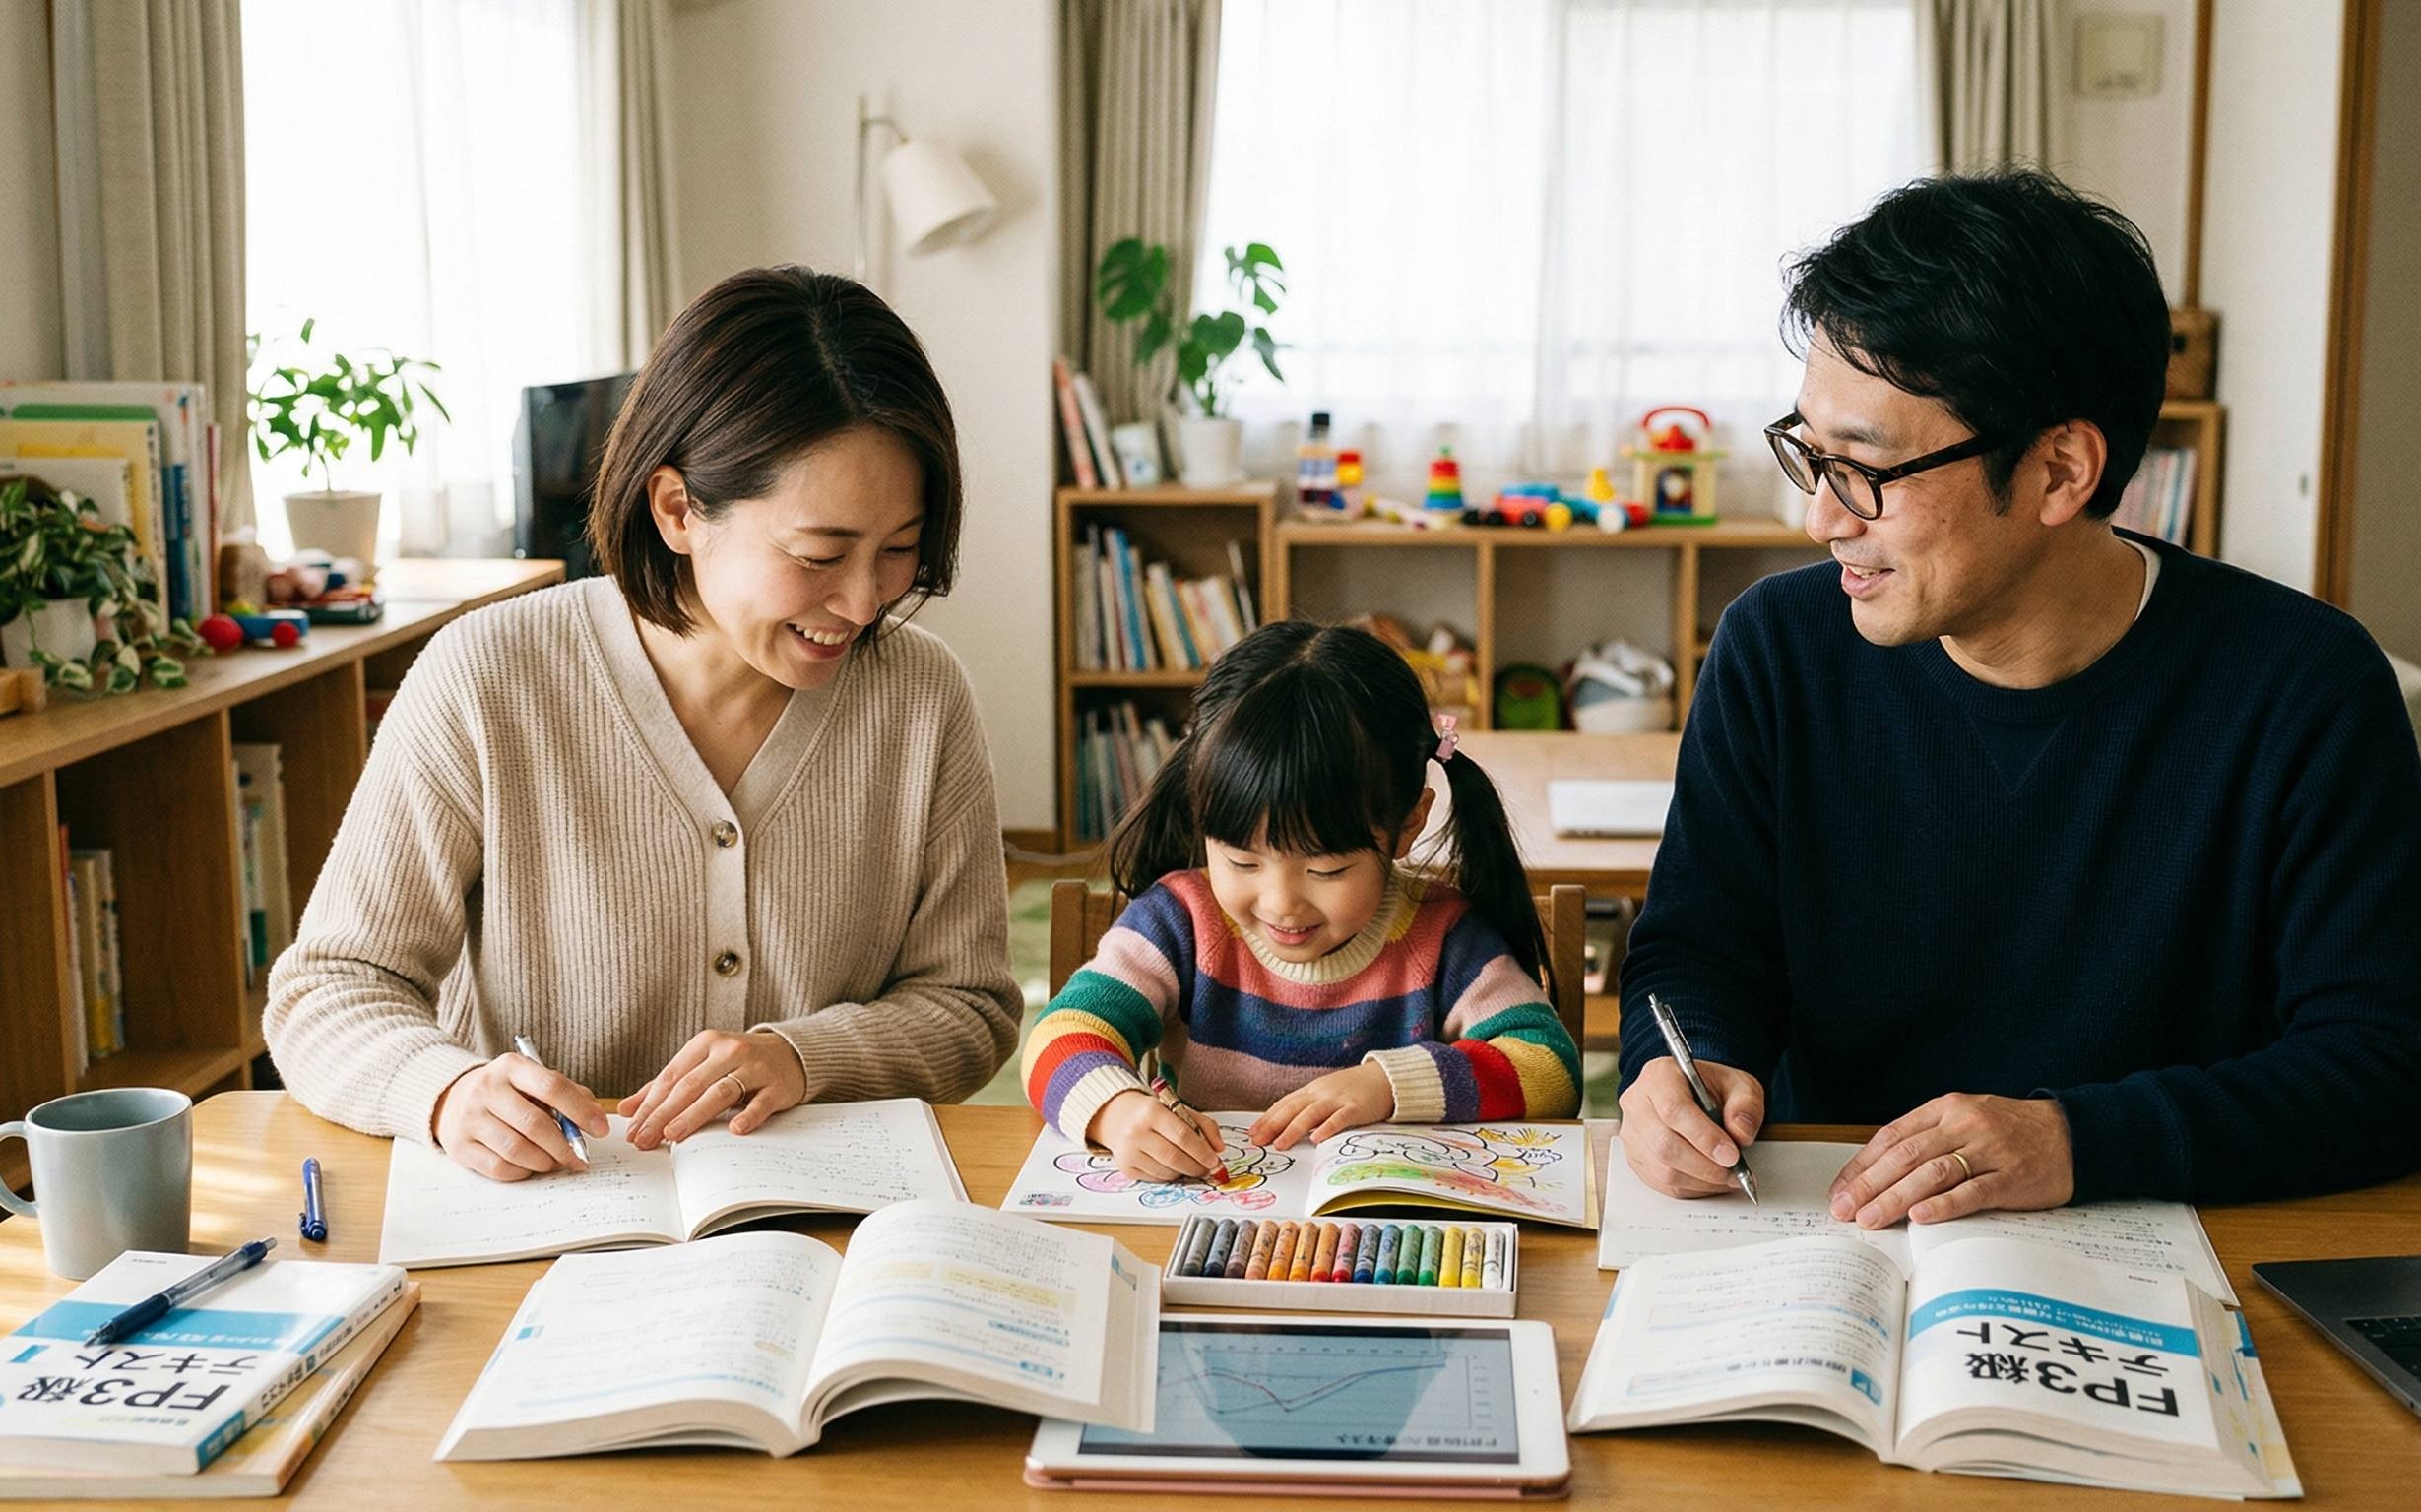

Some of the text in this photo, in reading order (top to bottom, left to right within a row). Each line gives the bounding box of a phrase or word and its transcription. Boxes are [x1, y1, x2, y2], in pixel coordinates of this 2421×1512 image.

[74, 1348, 261, 1375] テキスト
[1956, 1321, 2169, 1377] テキスト
[17, 1375, 231, 1412] FP3級
[1965, 1351, 2180, 1418] FP3級
